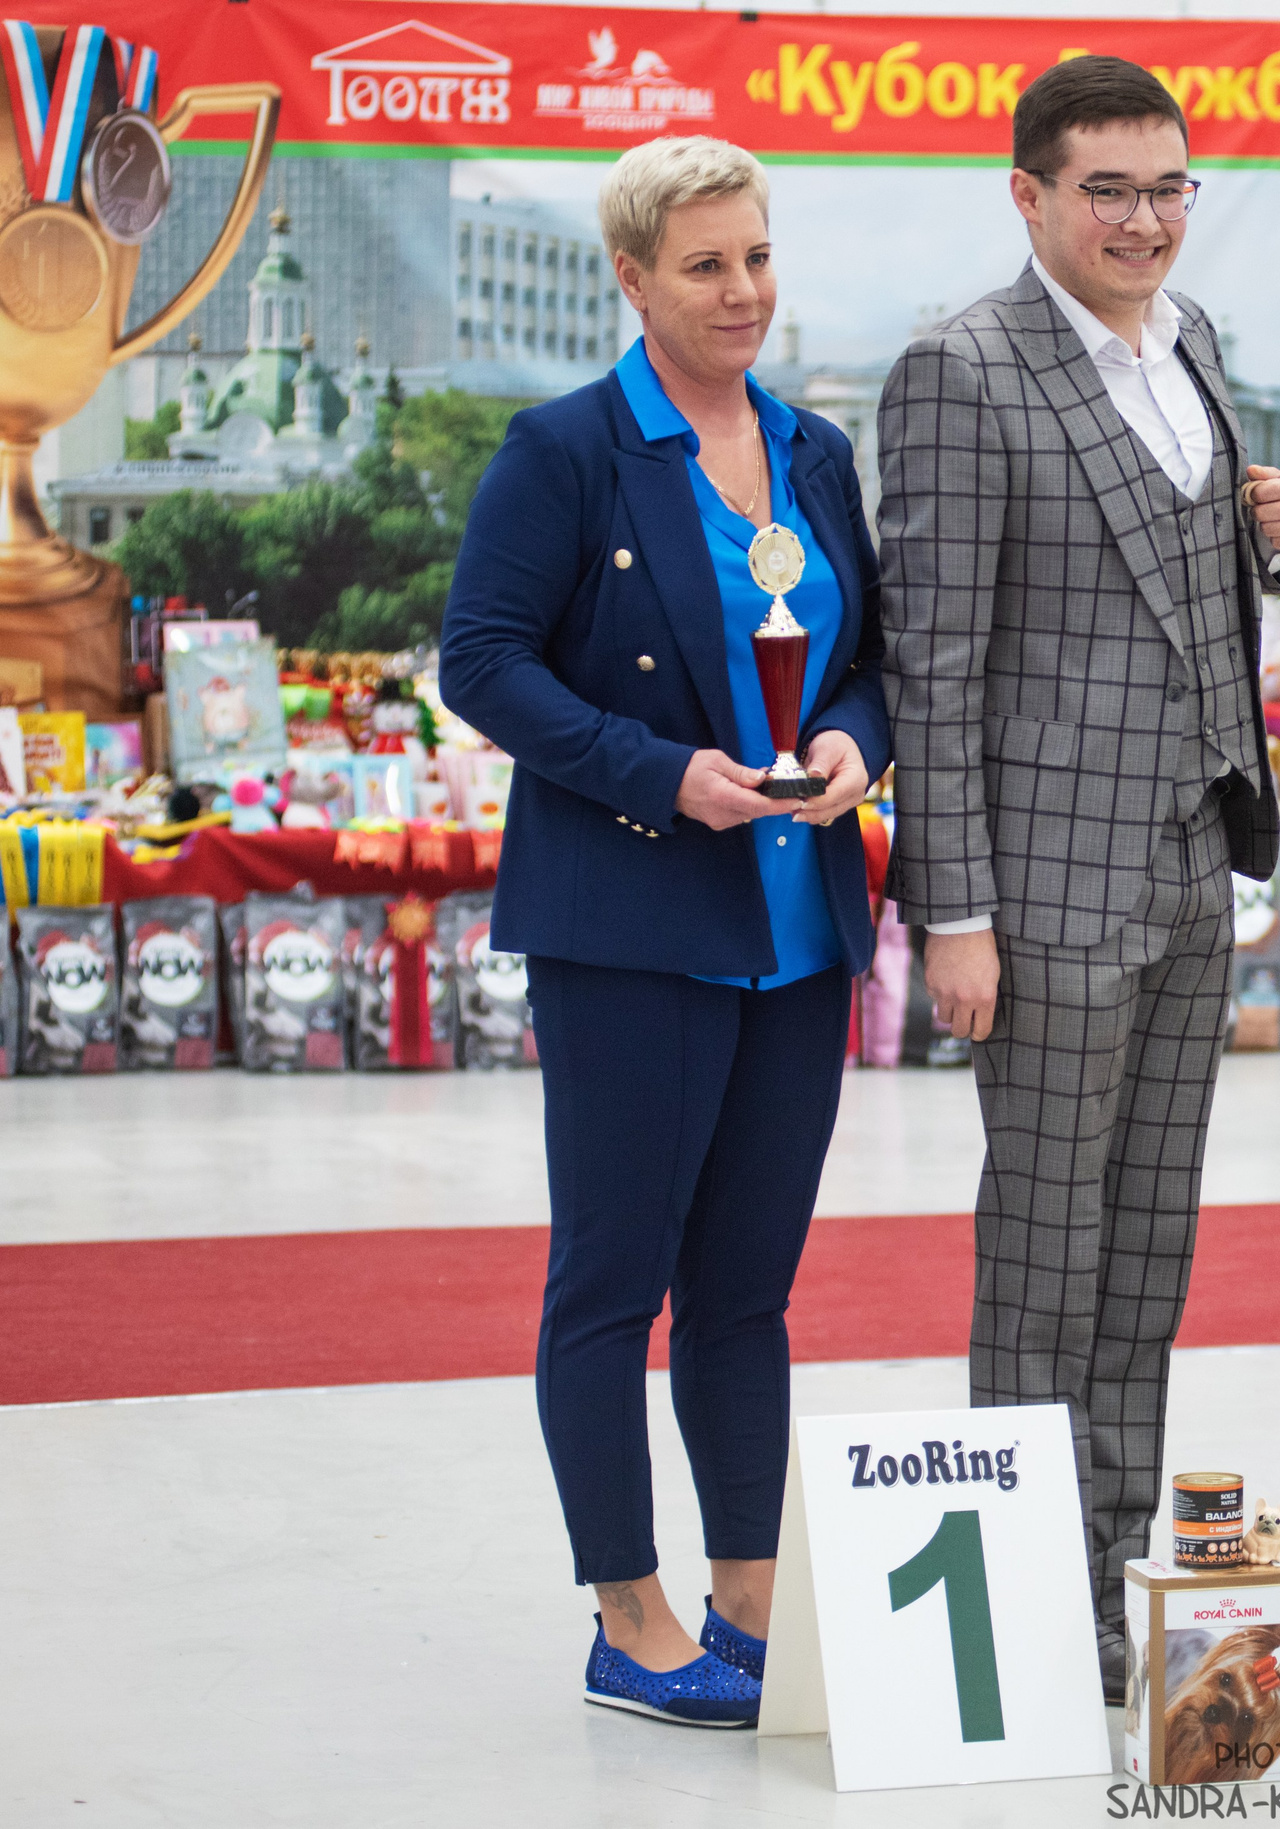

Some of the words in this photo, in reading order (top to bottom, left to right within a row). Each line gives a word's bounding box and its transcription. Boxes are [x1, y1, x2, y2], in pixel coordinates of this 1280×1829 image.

[746, 43, 1025, 132] «Кубок
[848, 1439, 1020, 1492] ZooRing
[888, 1510, 1005, 1743] 1
[1194, 1609, 1226, 1620] ROYAL
[1229, 1607, 1262, 1618] CANIN
